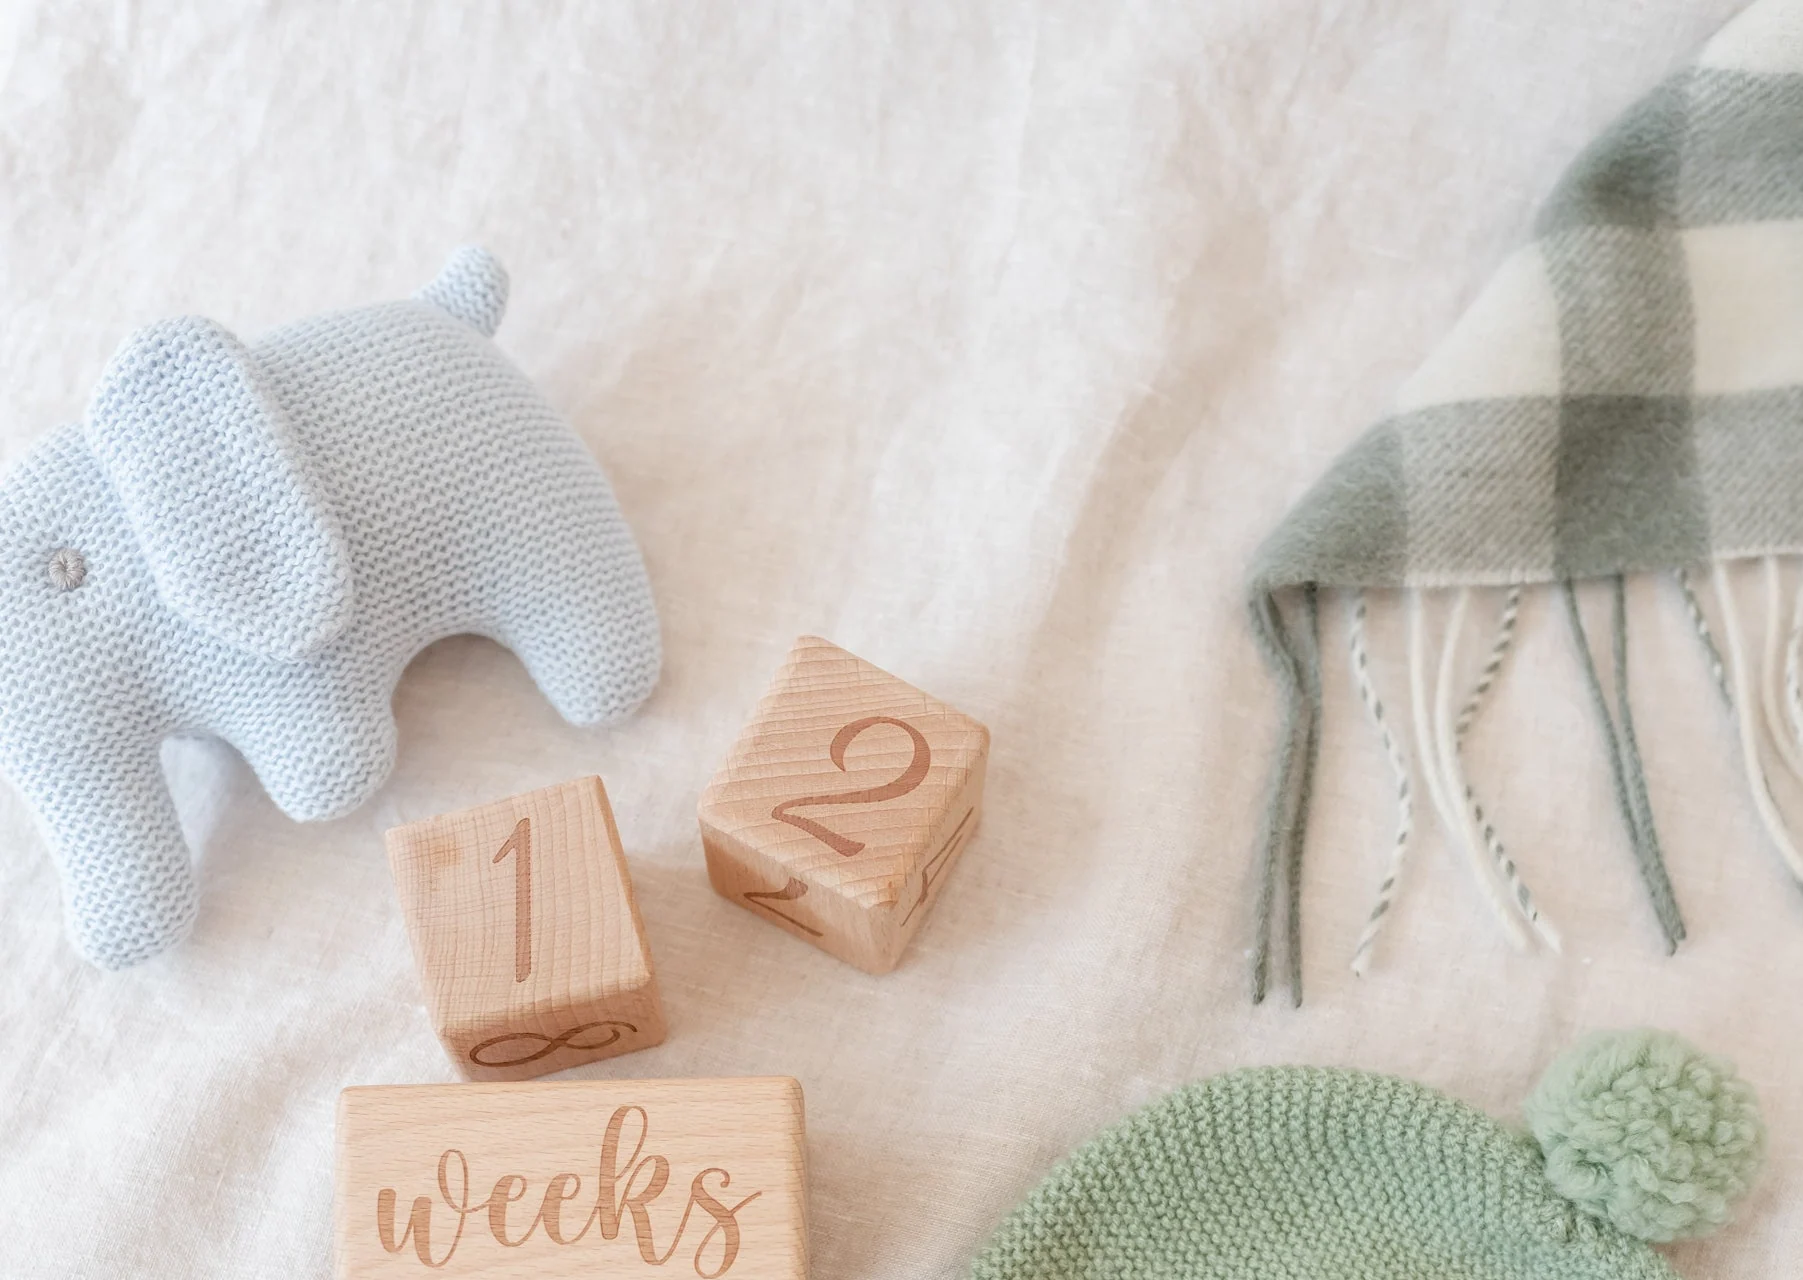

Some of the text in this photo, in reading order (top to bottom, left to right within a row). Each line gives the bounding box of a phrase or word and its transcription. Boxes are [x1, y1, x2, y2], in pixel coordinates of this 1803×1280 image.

[771, 716, 931, 858] 2
[493, 817, 531, 983] 1
[377, 1105, 762, 1279] weeks
